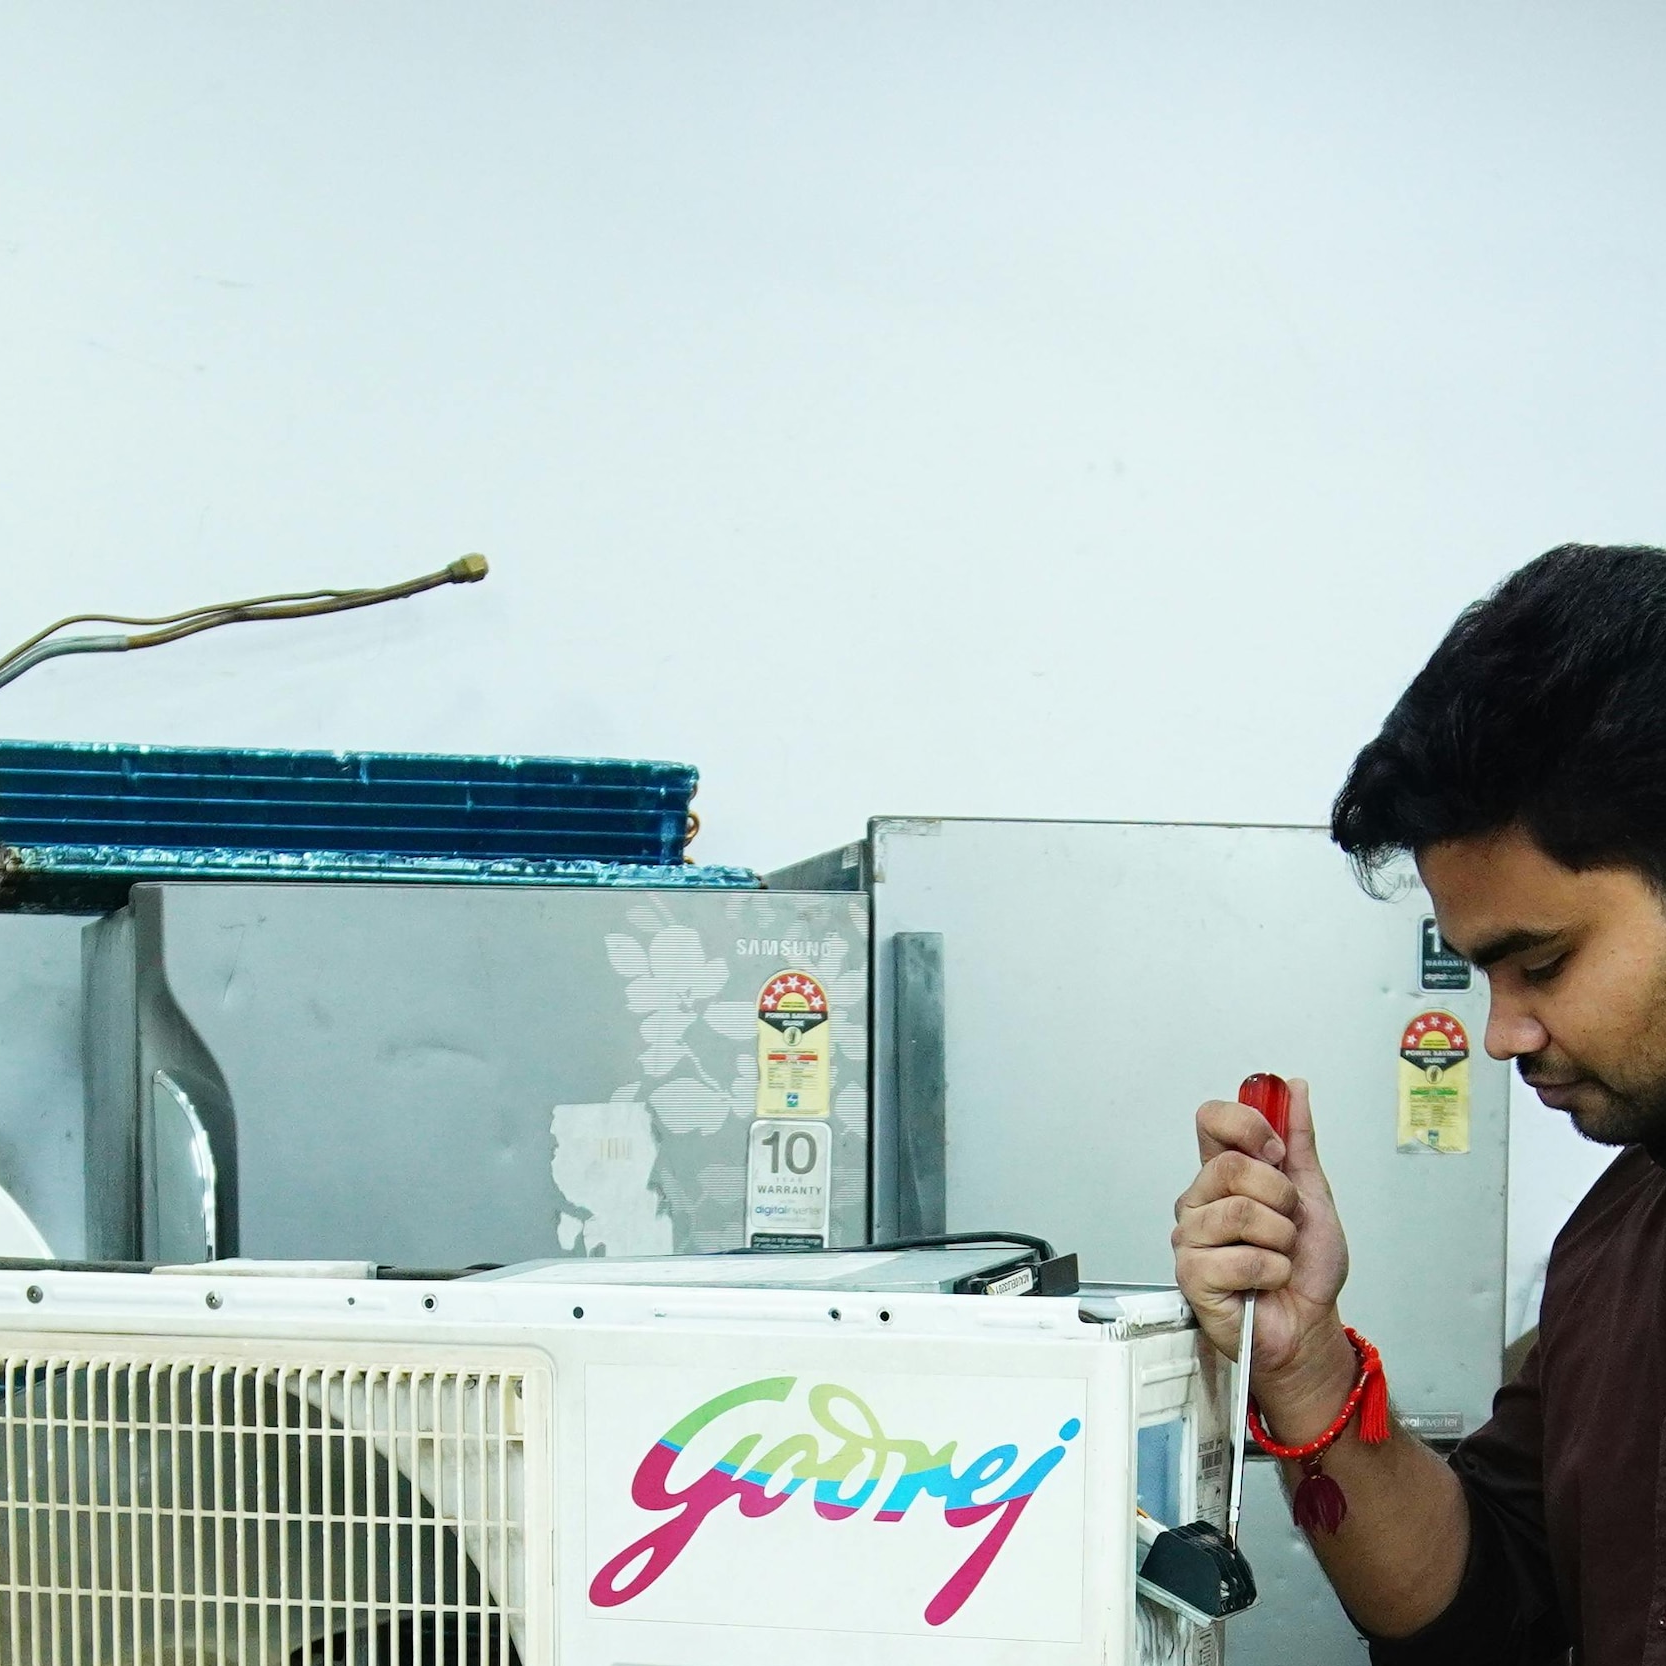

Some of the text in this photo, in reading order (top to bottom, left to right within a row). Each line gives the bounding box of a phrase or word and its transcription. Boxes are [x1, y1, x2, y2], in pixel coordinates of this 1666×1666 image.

[736, 939, 833, 956] SAMSUNG
[761, 1130, 817, 1175] 10
[757, 1185, 822, 1195] WARRANTY
[588, 1376, 1081, 1626] Godrej
